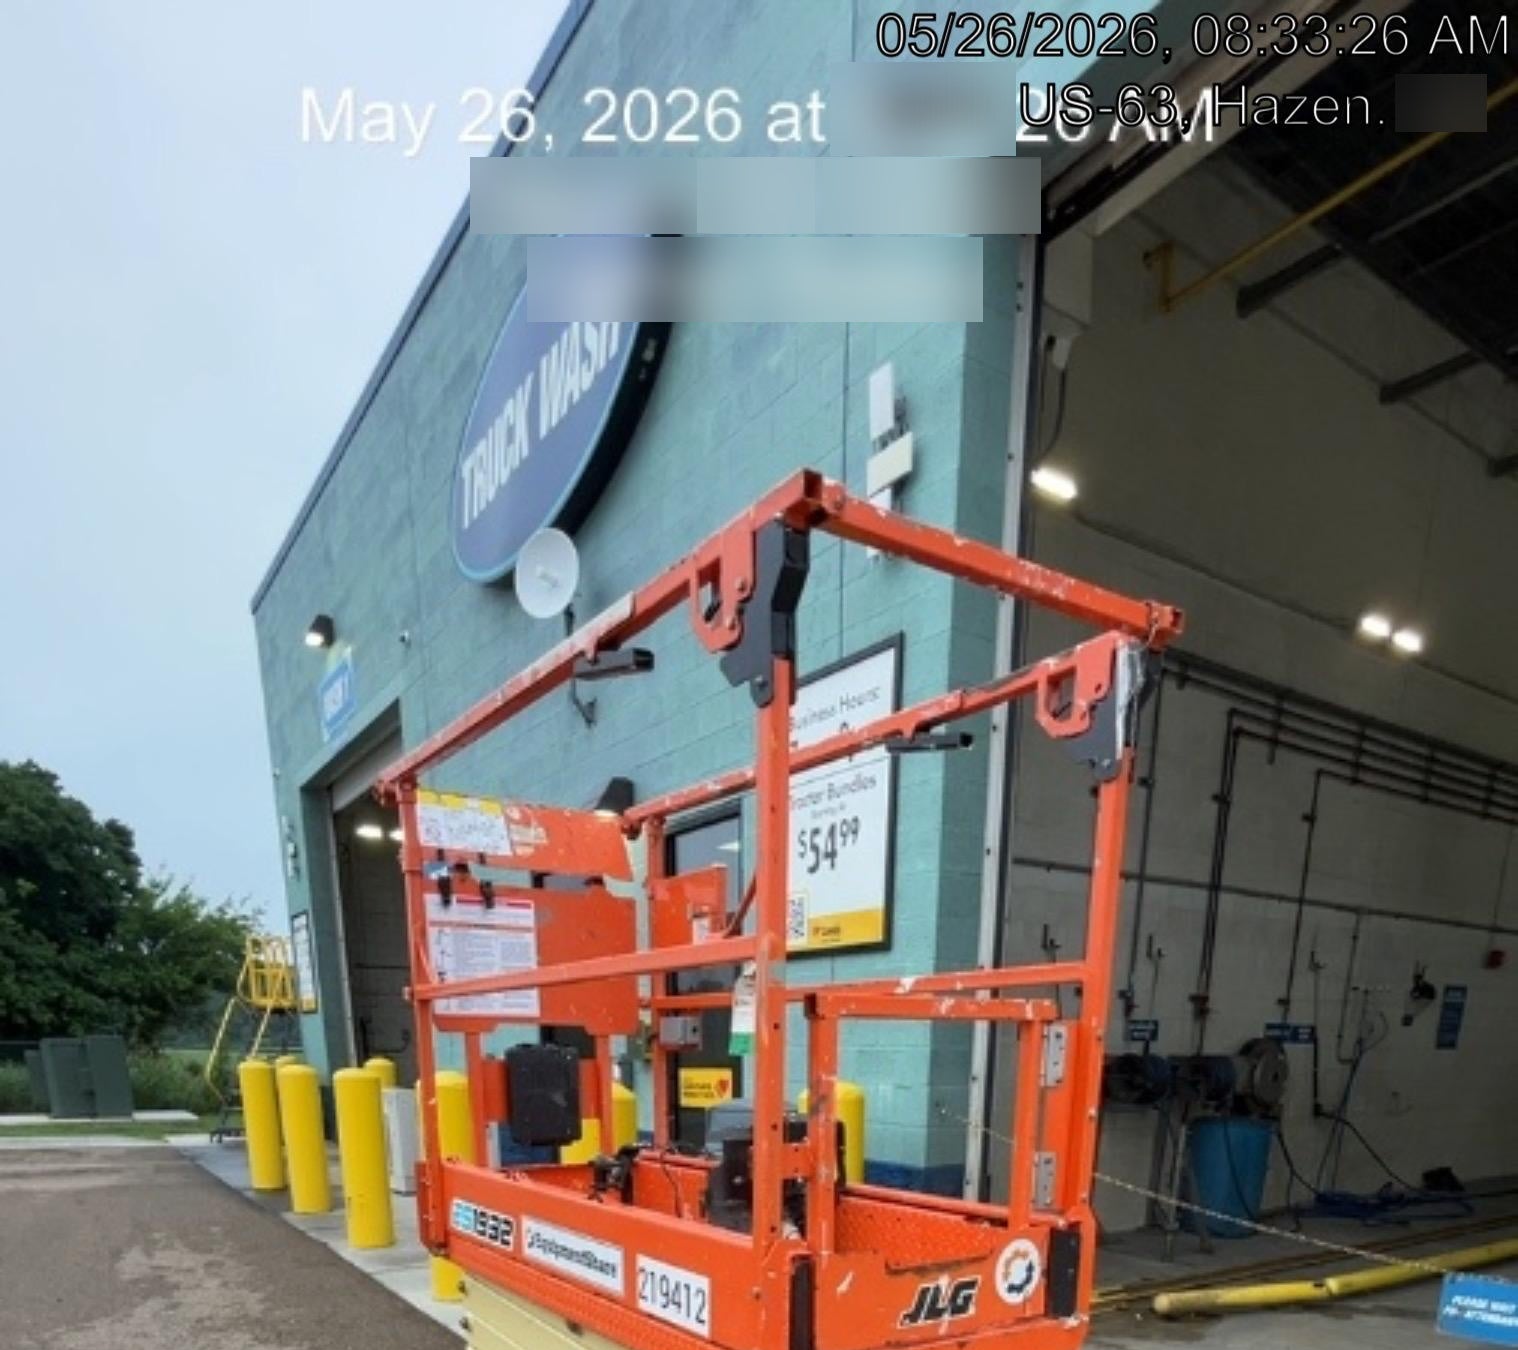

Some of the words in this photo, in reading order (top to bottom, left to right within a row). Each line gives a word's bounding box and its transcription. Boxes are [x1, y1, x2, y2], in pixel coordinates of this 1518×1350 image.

[462, 371, 534, 530] TRUCK
[454, 1202, 513, 1247] ES1932
[639, 1266, 706, 1325] 219412
[899, 1276, 979, 1327] JLG
